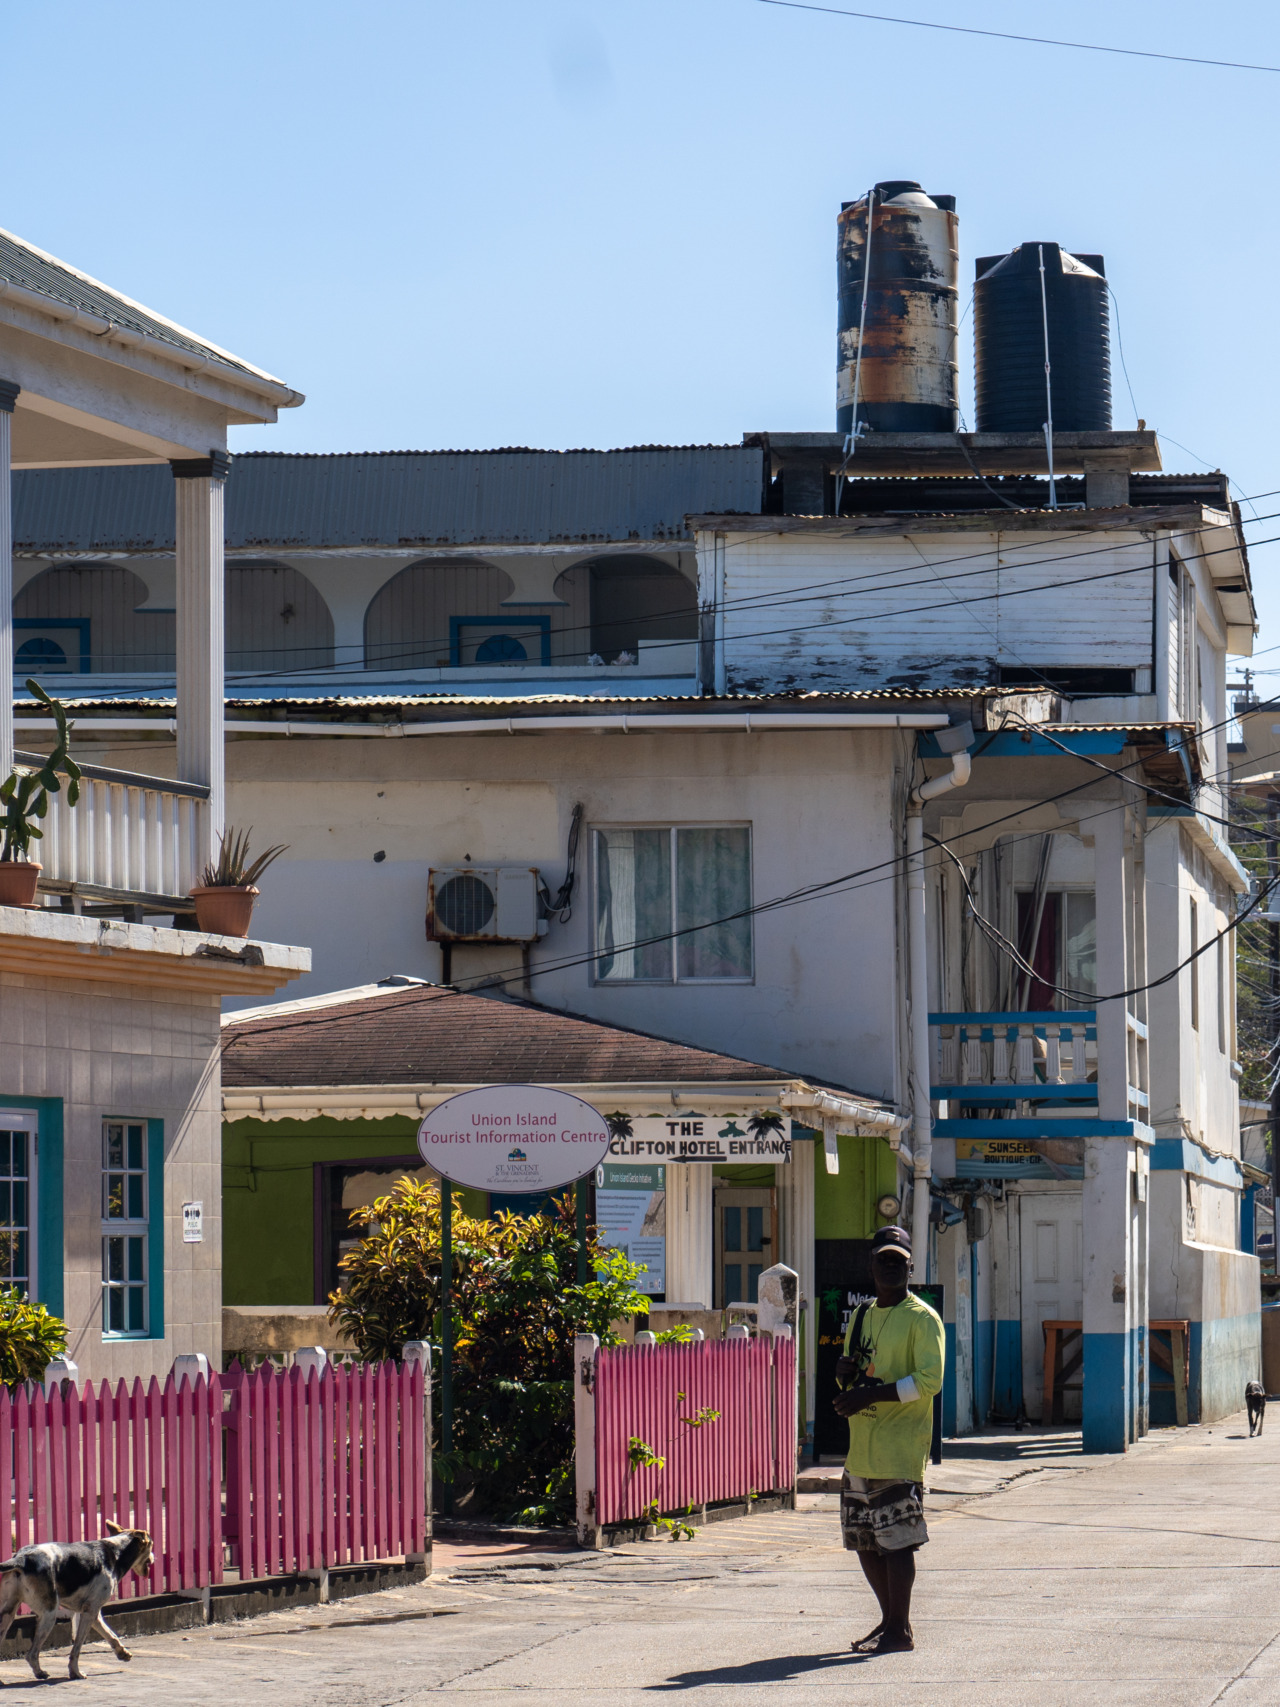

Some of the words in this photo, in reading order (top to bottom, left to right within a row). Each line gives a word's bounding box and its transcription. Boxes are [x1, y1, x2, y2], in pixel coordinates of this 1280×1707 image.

[471, 1113, 511, 1126] Union
[516, 1112, 557, 1126] Island
[665, 1121, 704, 1136] THE
[421, 1131, 471, 1144] Tourist
[476, 1130, 556, 1143] Information
[561, 1130, 606, 1143] Centre
[609, 1140, 675, 1155] CLIFTON
[679, 1140, 726, 1155] HOTEL
[729, 1140, 792, 1155] ENTRANCE
[983, 1155, 1024, 1164] BOUTIQUE
[1029, 1155, 1043, 1164] GIF
[506, 1164, 539, 1172] VINCENT
